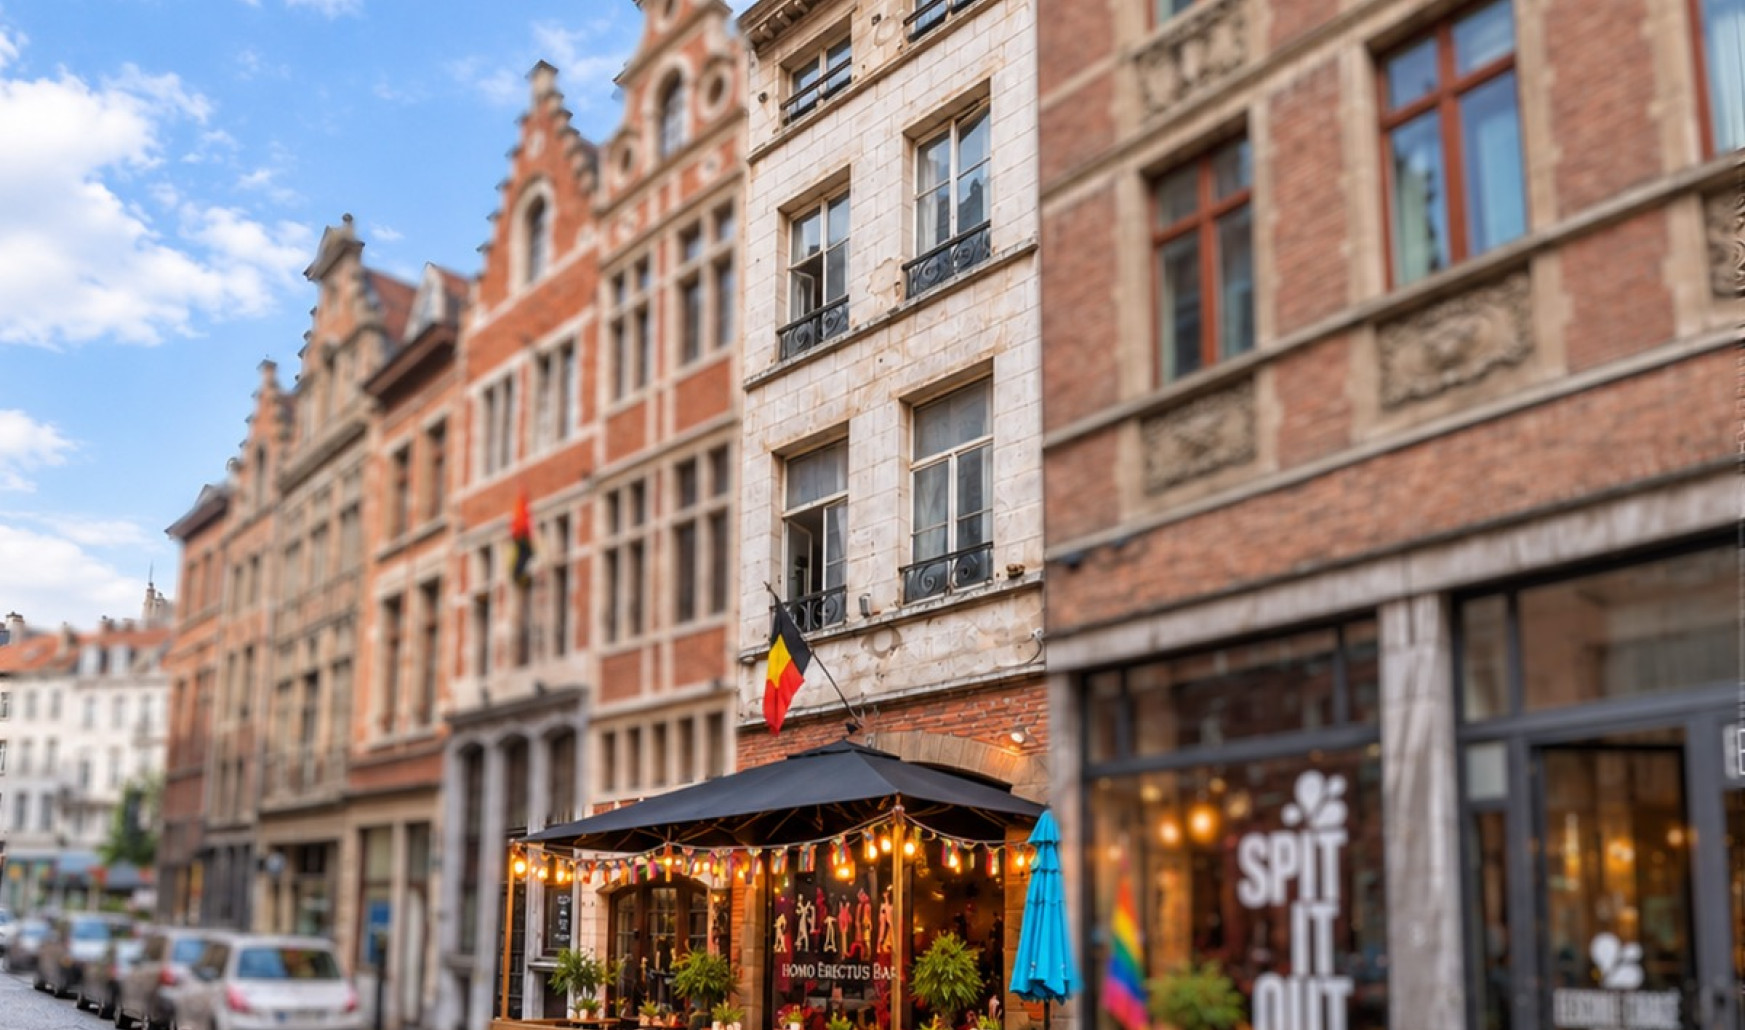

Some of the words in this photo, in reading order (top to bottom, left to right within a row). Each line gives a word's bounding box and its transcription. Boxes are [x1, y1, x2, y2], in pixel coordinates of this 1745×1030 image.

[1238, 831, 1347, 908] SPIT
[1291, 902, 1339, 975] IT
[1253, 973, 1353, 1030] OUT
